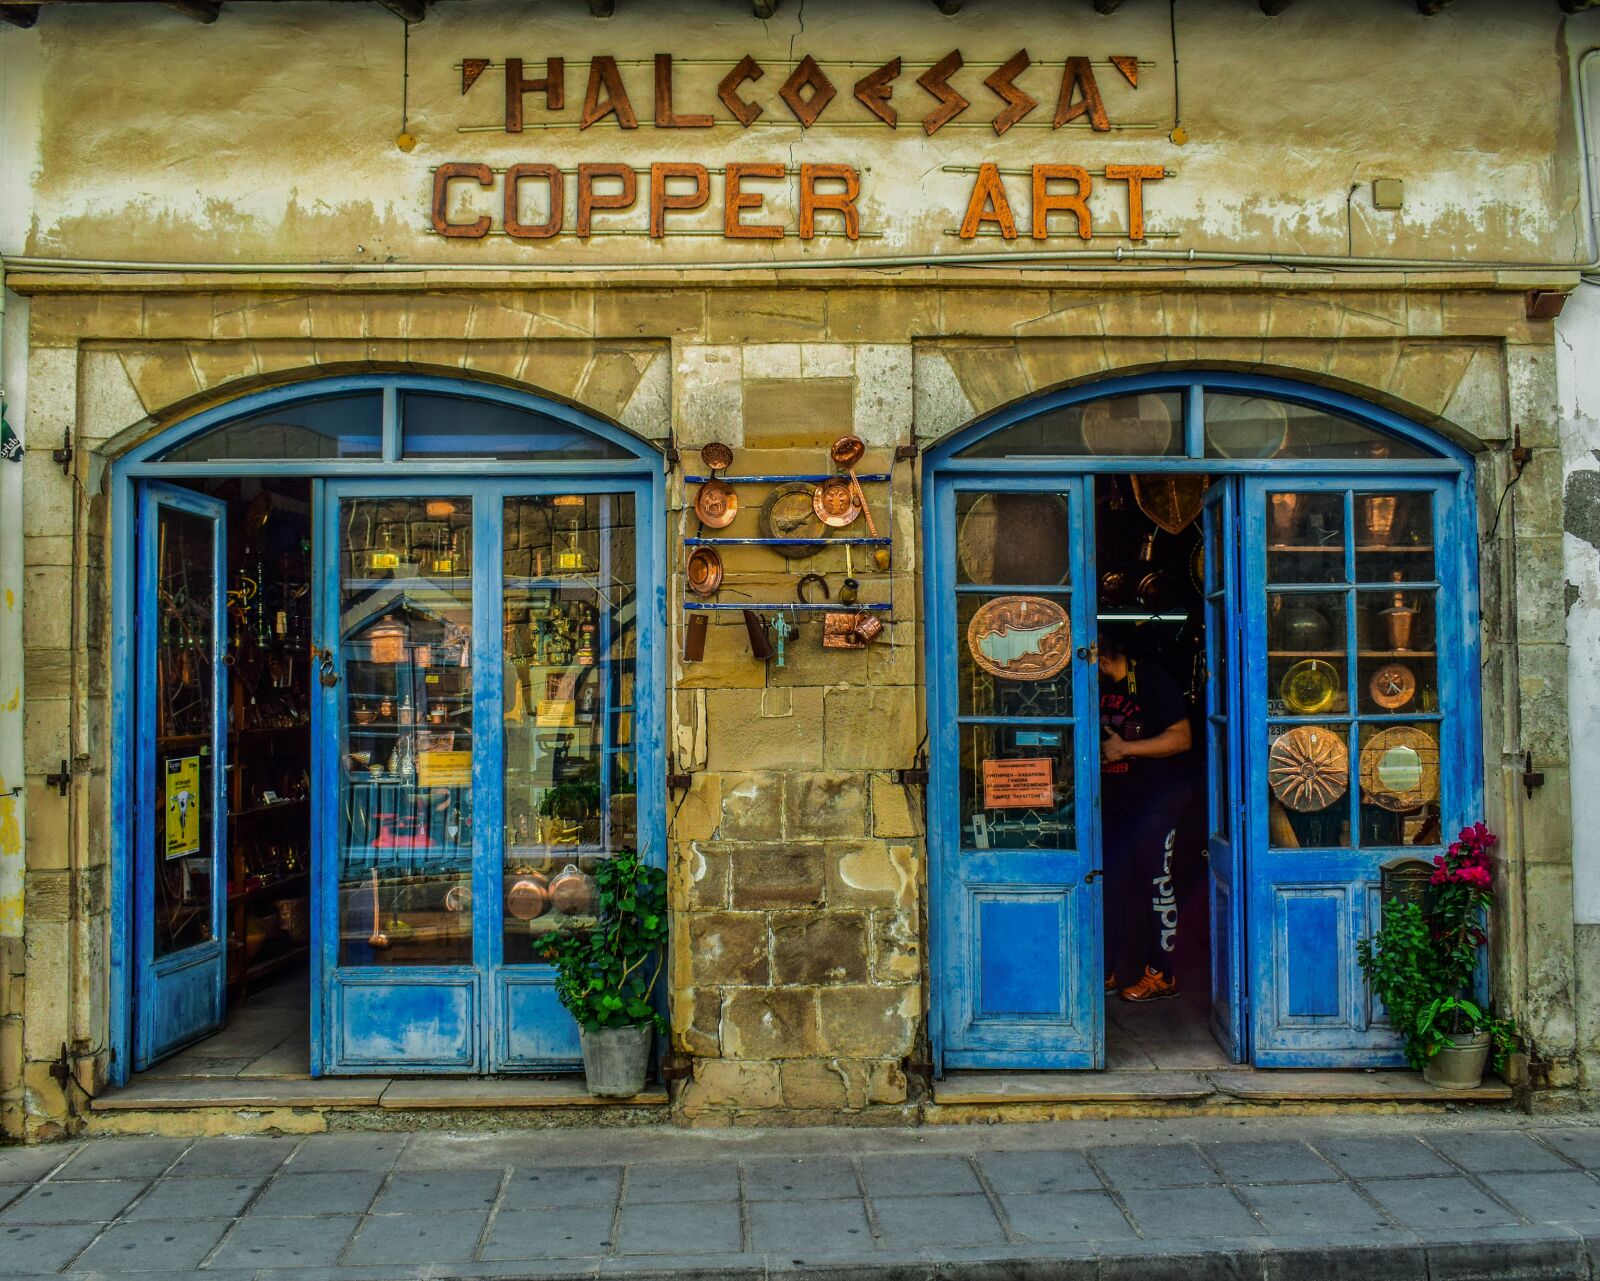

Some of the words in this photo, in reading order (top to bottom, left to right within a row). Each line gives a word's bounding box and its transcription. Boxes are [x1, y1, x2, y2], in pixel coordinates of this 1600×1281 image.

[432, 162, 860, 239] COPPER
[959, 163, 1165, 241] ART
[1152, 828, 1178, 952] adidas
